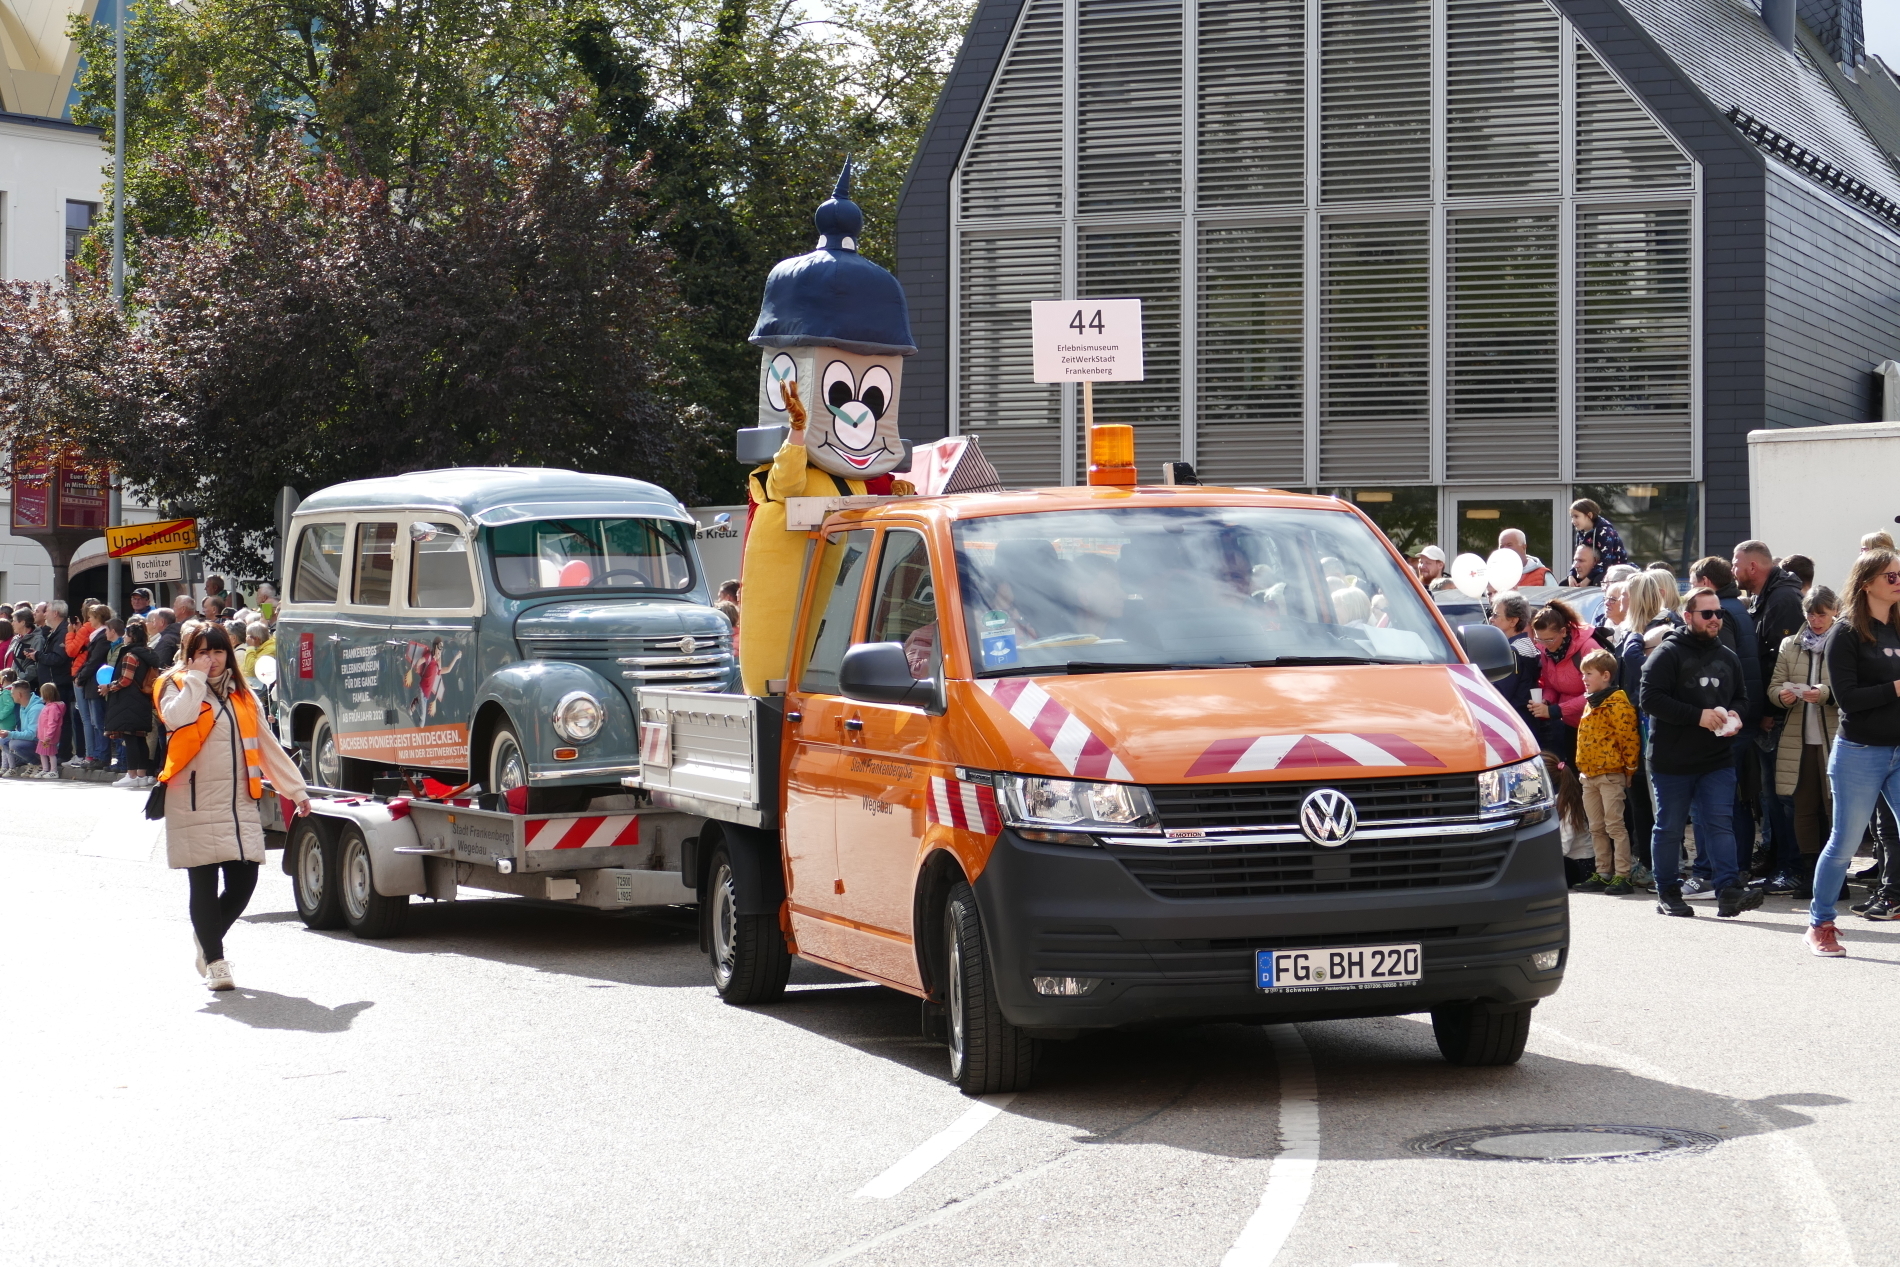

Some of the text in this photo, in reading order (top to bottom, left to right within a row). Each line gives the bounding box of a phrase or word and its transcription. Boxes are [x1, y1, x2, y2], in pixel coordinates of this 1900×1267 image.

[1069, 309, 1105, 335] 44
[1057, 343, 1119, 352] Erlebnismuseum
[1061, 355, 1116, 364] ZeitWerkStadt
[1065, 367, 1113, 376] Frankenberg
[113, 530, 190, 549] Umleitung
[706, 529, 738, 539] Kreuz
[136, 559, 172, 569] Rochlitzer
[143, 569, 167, 580] Straße
[342, 645, 377, 660] FRANKENBERGS
[341, 660, 380, 675] ERLEBNISMUSEUM
[344, 676, 378, 689] FÜR DIE GANZE
[342, 710, 384, 723] AB FRÜHJAHR 2021
[340, 730, 462, 751] SACHSENS PIONIERGEIST ENTDECKEN.
[398, 749, 409, 760] NUR
[410, 750, 414, 759] IN
[415, 748, 426, 758] DER
[850, 756, 866, 772] Stadt
[862, 794, 894, 816] Wegebau
[452, 823, 469, 837] Stadt
[457, 840, 487, 856] Wegebau
[1262, 948, 1418, 982] D FG BH 220
